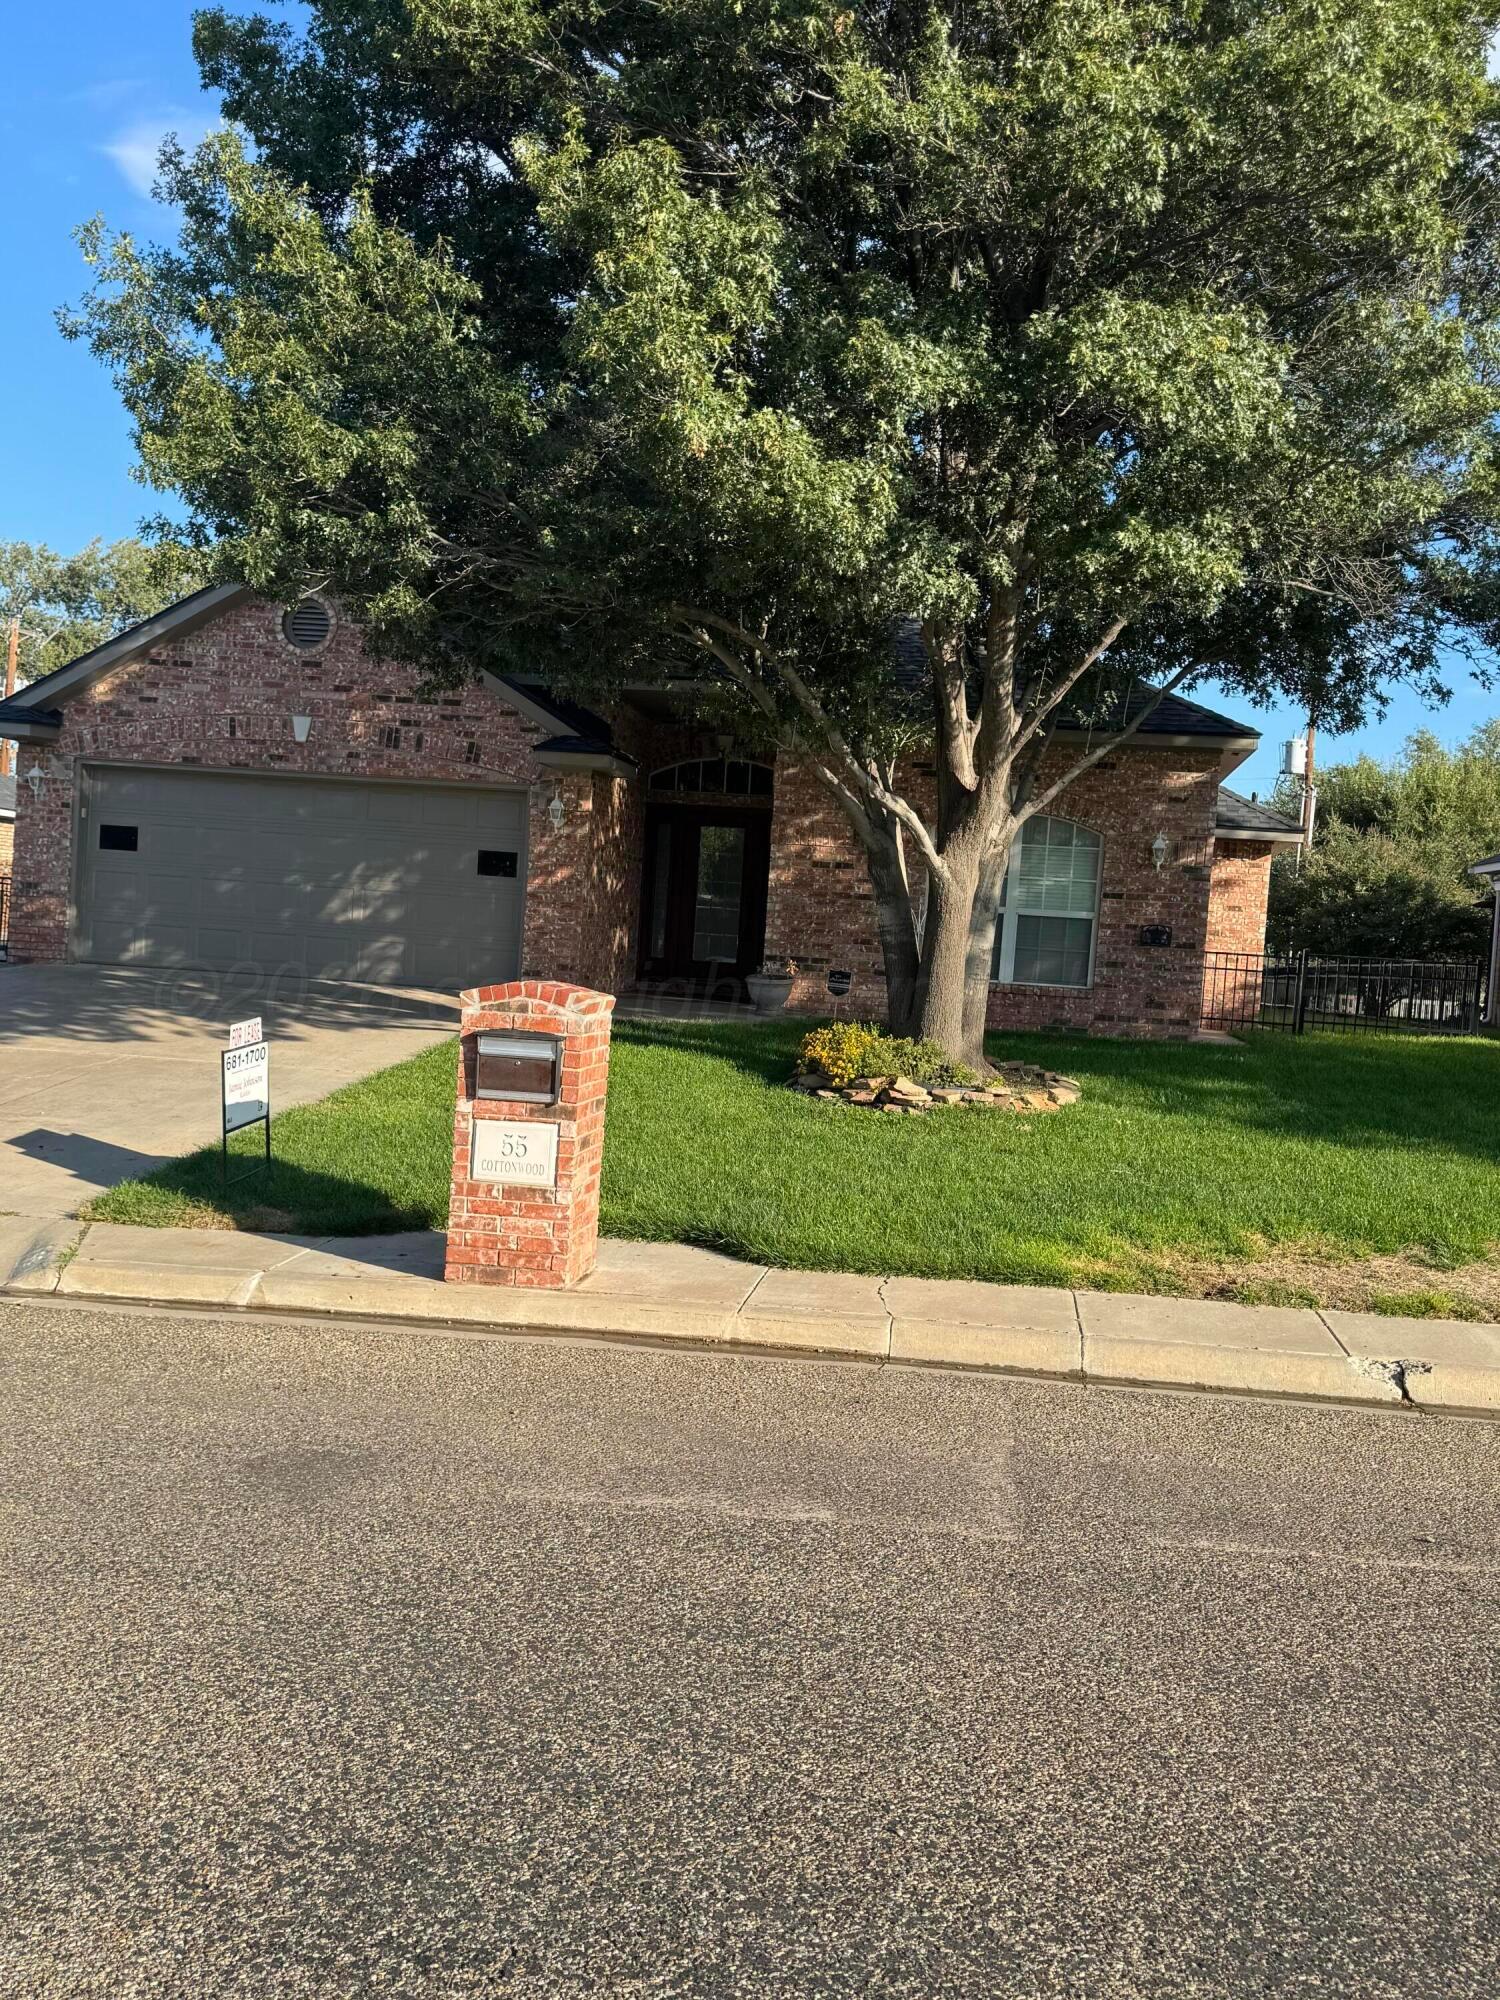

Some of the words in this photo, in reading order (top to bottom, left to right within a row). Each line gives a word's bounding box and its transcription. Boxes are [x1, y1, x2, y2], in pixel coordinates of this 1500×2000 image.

[232, 1027, 242, 1047] FOR
[244, 1022, 261, 1043] LEASE
[226, 1046, 266, 1071] 681-1700
[501, 1133, 528, 1158] 55
[481, 1159, 545, 1177] COTTONWOOD
